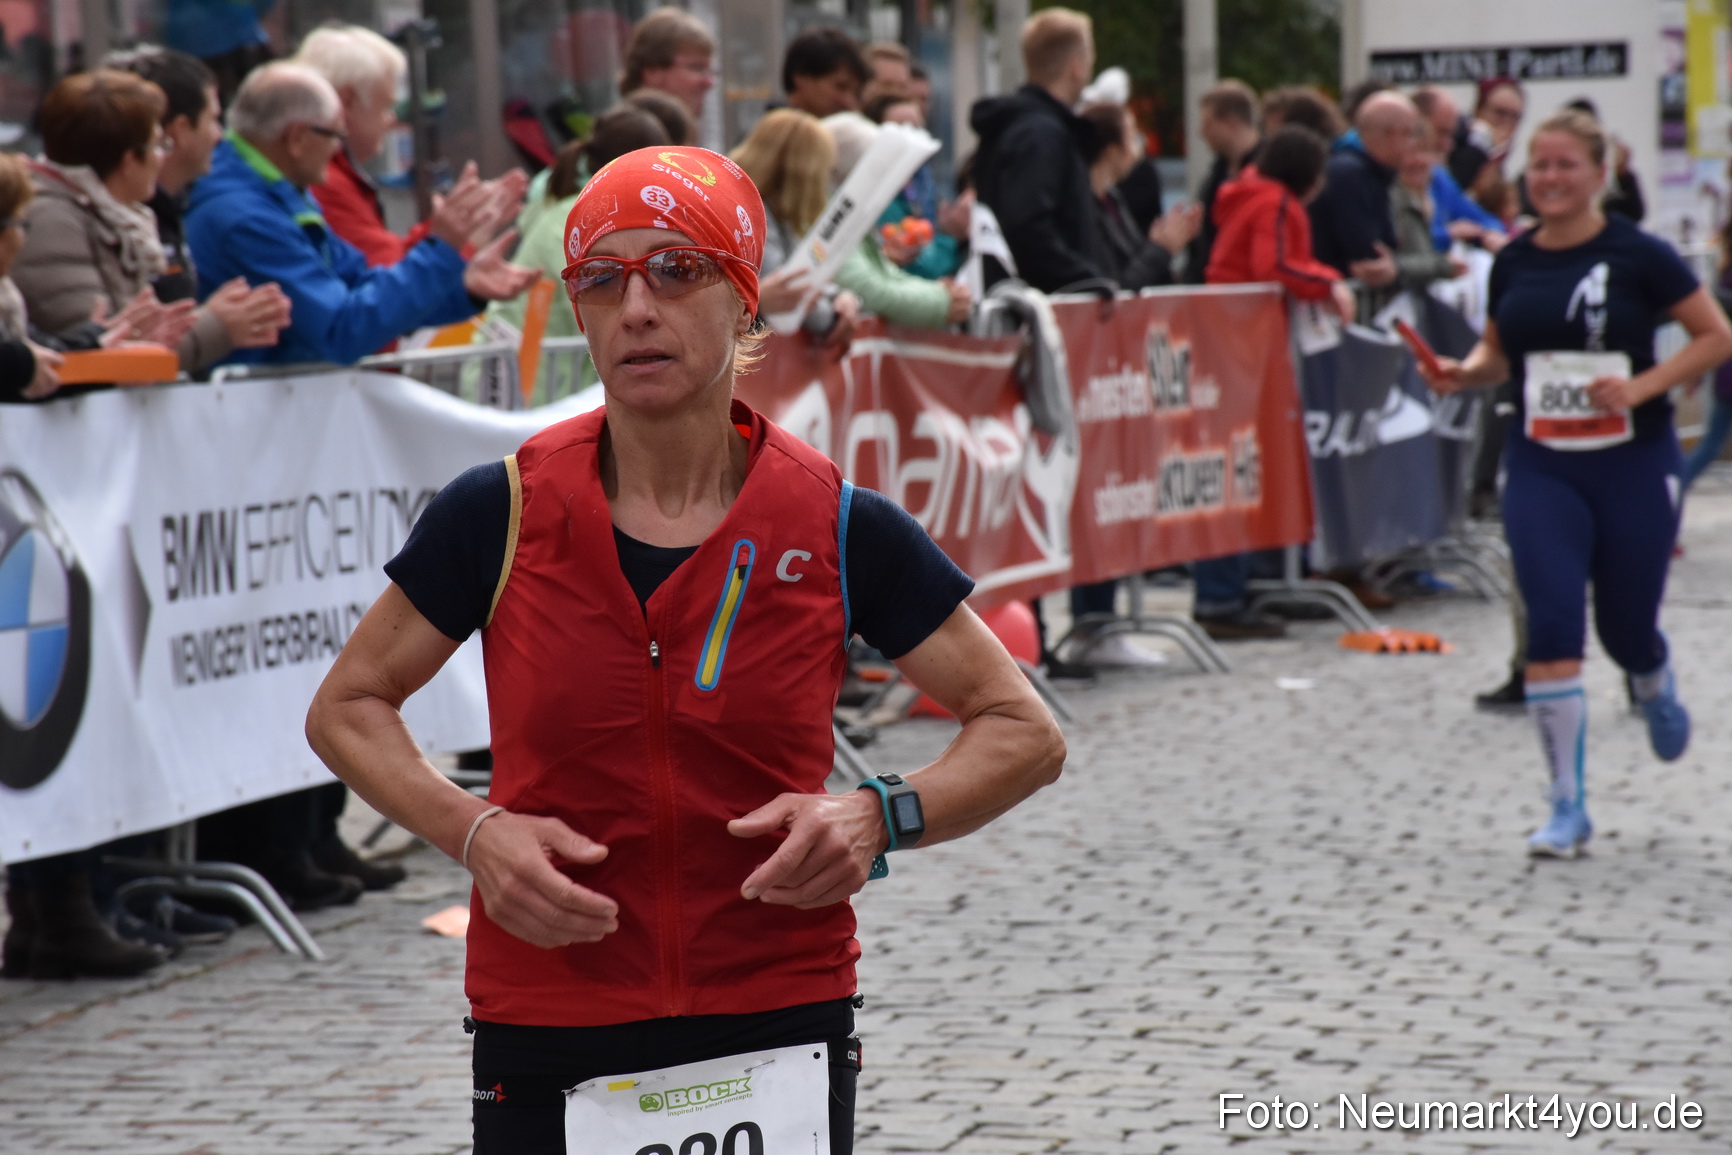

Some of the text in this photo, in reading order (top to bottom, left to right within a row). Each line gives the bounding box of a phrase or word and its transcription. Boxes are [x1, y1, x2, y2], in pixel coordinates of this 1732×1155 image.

[646, 190, 670, 207] 33
[651, 163, 711, 202] Sieger
[162, 508, 238, 601] BMW
[776, 549, 812, 582] C
[664, 1076, 752, 1110] BOCK
[667, 1106, 694, 1117] inspired
[704, 1099, 723, 1109] smart
[724, 1092, 753, 1104] concepts
